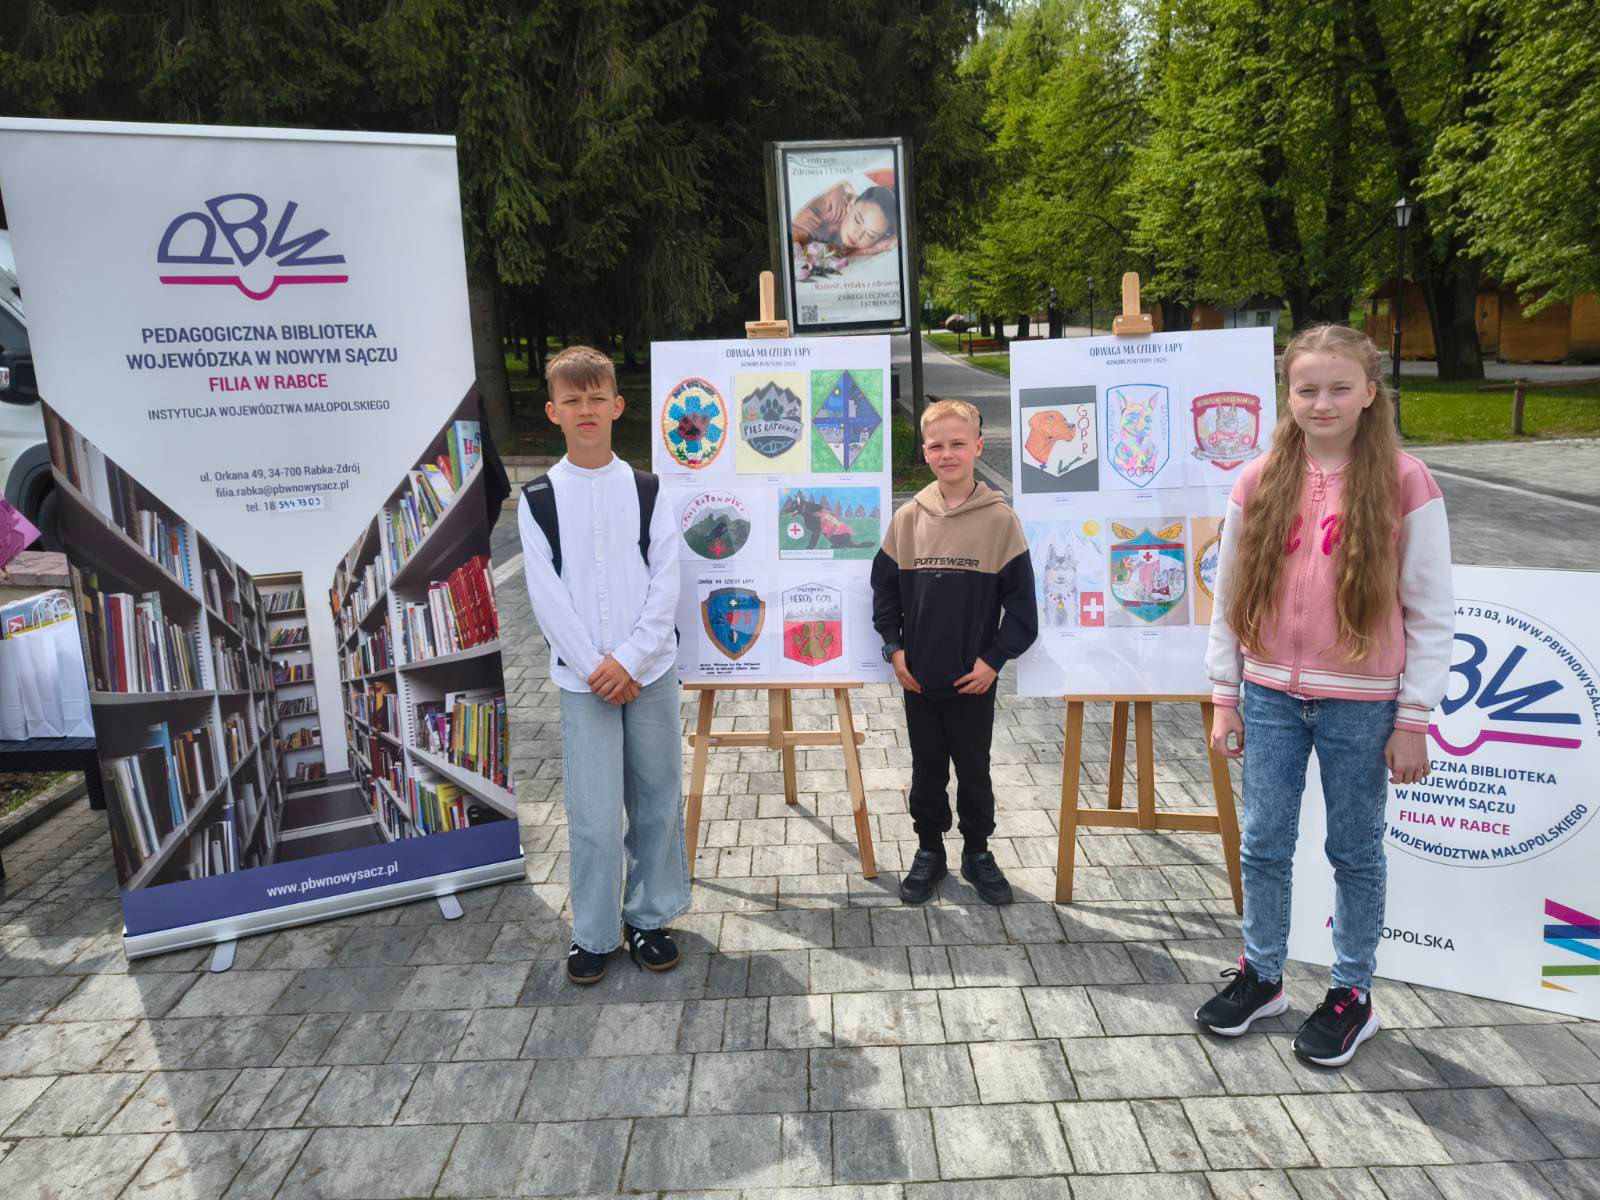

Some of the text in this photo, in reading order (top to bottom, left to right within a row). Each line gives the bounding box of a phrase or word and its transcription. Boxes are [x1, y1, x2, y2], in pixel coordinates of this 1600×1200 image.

[157, 193, 346, 267] PBW
[141, 323, 377, 343] PEDAGOGICZNA BIBLIOTEKA
[126, 347, 398, 370] WOJEWÓDZKA W NOWYM SĄCZU
[726, 348, 755, 358] ODWAGA
[756, 348, 767, 357] MA
[769, 347, 792, 357] CZTERY
[1089, 346, 1121, 357] ODWAGA
[1123, 344, 1135, 355] MA
[1136, 343, 1162, 354] CZTERY
[209, 373, 328, 392] FILIA W RABCE
[148, 400, 390, 420] INSTYTUCJA WOJEWÓDZTWA MAŁOPOLSKIEGO
[200, 463, 360, 482] ul. Orkana 49, 34-700 Rabka-Zdrój
[216, 480, 350, 498] filia.rabka@pbwnowysacz.pl
[246, 502, 261, 513] tel.
[264, 501, 276, 511] 18
[1467, 607, 1481, 618] 73
[1470, 764, 1558, 786] BIBLIOTEKA
[1412, 774, 1507, 797] OJEWÓDZKA
[1395, 788, 1516, 815] W NOWYM SĄCZU
[1389, 802, 1589, 862] WOJEWÓDZTWA MAŁOPOLSKIEGO
[1399, 809, 1511, 837] FILIA W RABCE
[266, 860, 399, 897] www.pbwnowysacz.pl
